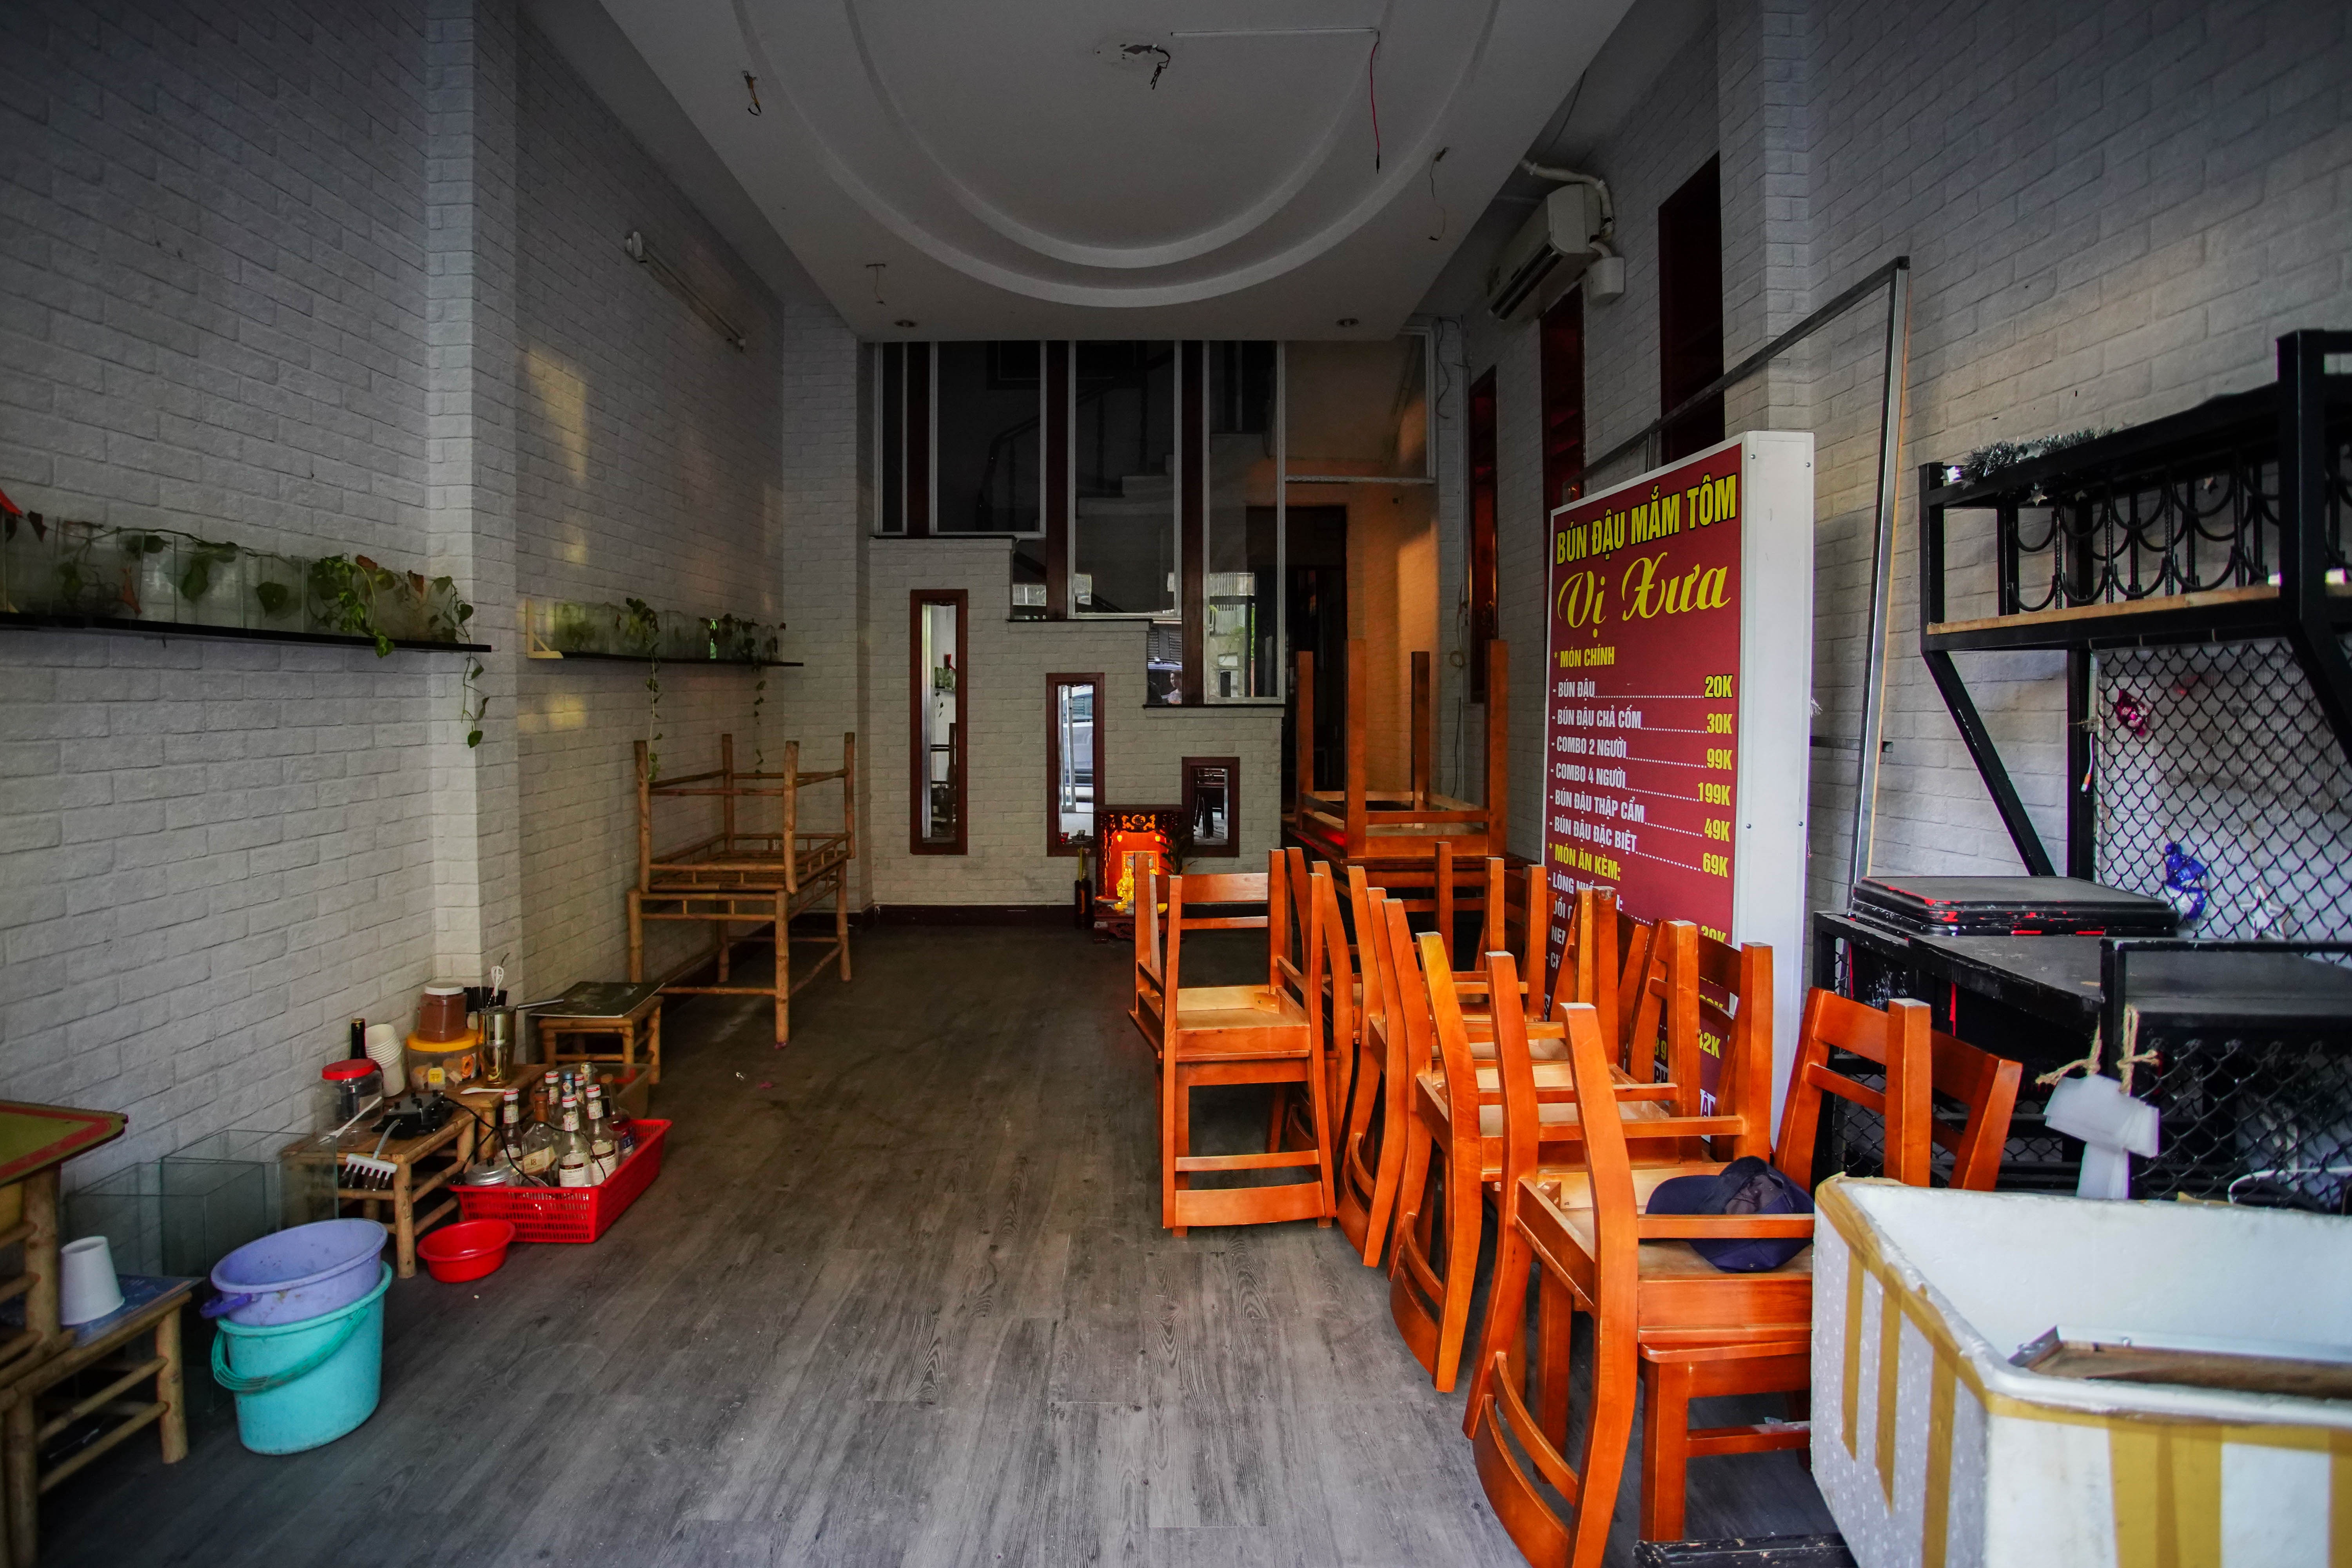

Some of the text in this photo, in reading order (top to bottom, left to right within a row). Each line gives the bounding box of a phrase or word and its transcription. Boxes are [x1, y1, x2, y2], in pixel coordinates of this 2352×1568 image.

[1556, 474, 1737, 565] BÚN ĐẬU MẮM TÔM
[1557, 552, 1731, 638] Vị Xưa
[1560, 643, 1615, 667] MÓN CHÍNH
[1558, 674, 1733, 701] BÚN ĐẬU 20K
[1557, 705, 1733, 734] BÚN ĐẬU CHẢ CỐM 30K
[1556, 736, 1732, 770] COMBO 2 NGƯỜI 99K
[1555, 763, 1731, 806] COMBO 4 NGƯỜI 199K
[1555, 787, 1730, 842] BÚN ĐẬU THẬP CẨM 49K
[1554, 814, 1728, 878] BÚN ĐẬU ĐẶC BIỆT 69K
[1555, 843, 1621, 882] MÓN ĂN KÈM:
[1553, 870, 1574, 895] LÒNG
